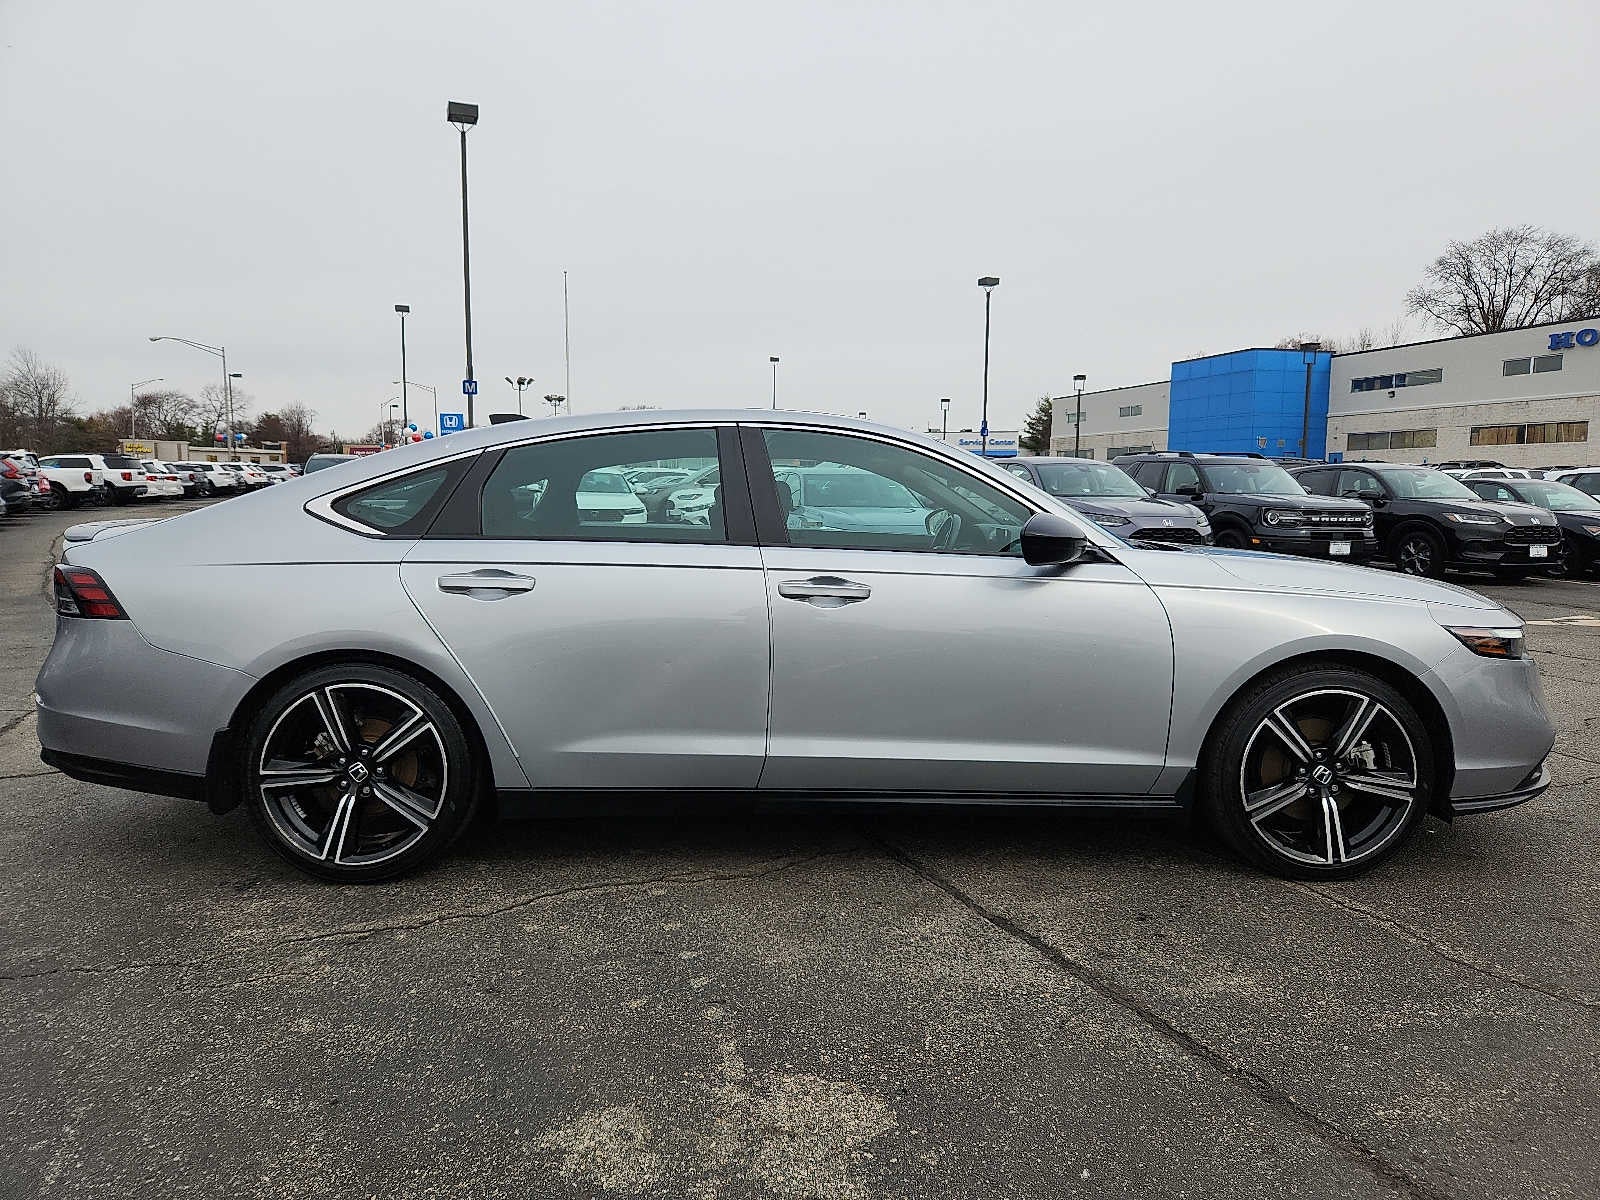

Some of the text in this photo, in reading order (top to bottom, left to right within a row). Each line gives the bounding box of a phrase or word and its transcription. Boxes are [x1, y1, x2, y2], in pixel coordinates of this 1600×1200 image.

[1547, 328, 1600, 350] HO
[464, 382, 476, 393] M
[959, 438, 1016, 446] Servic Center
